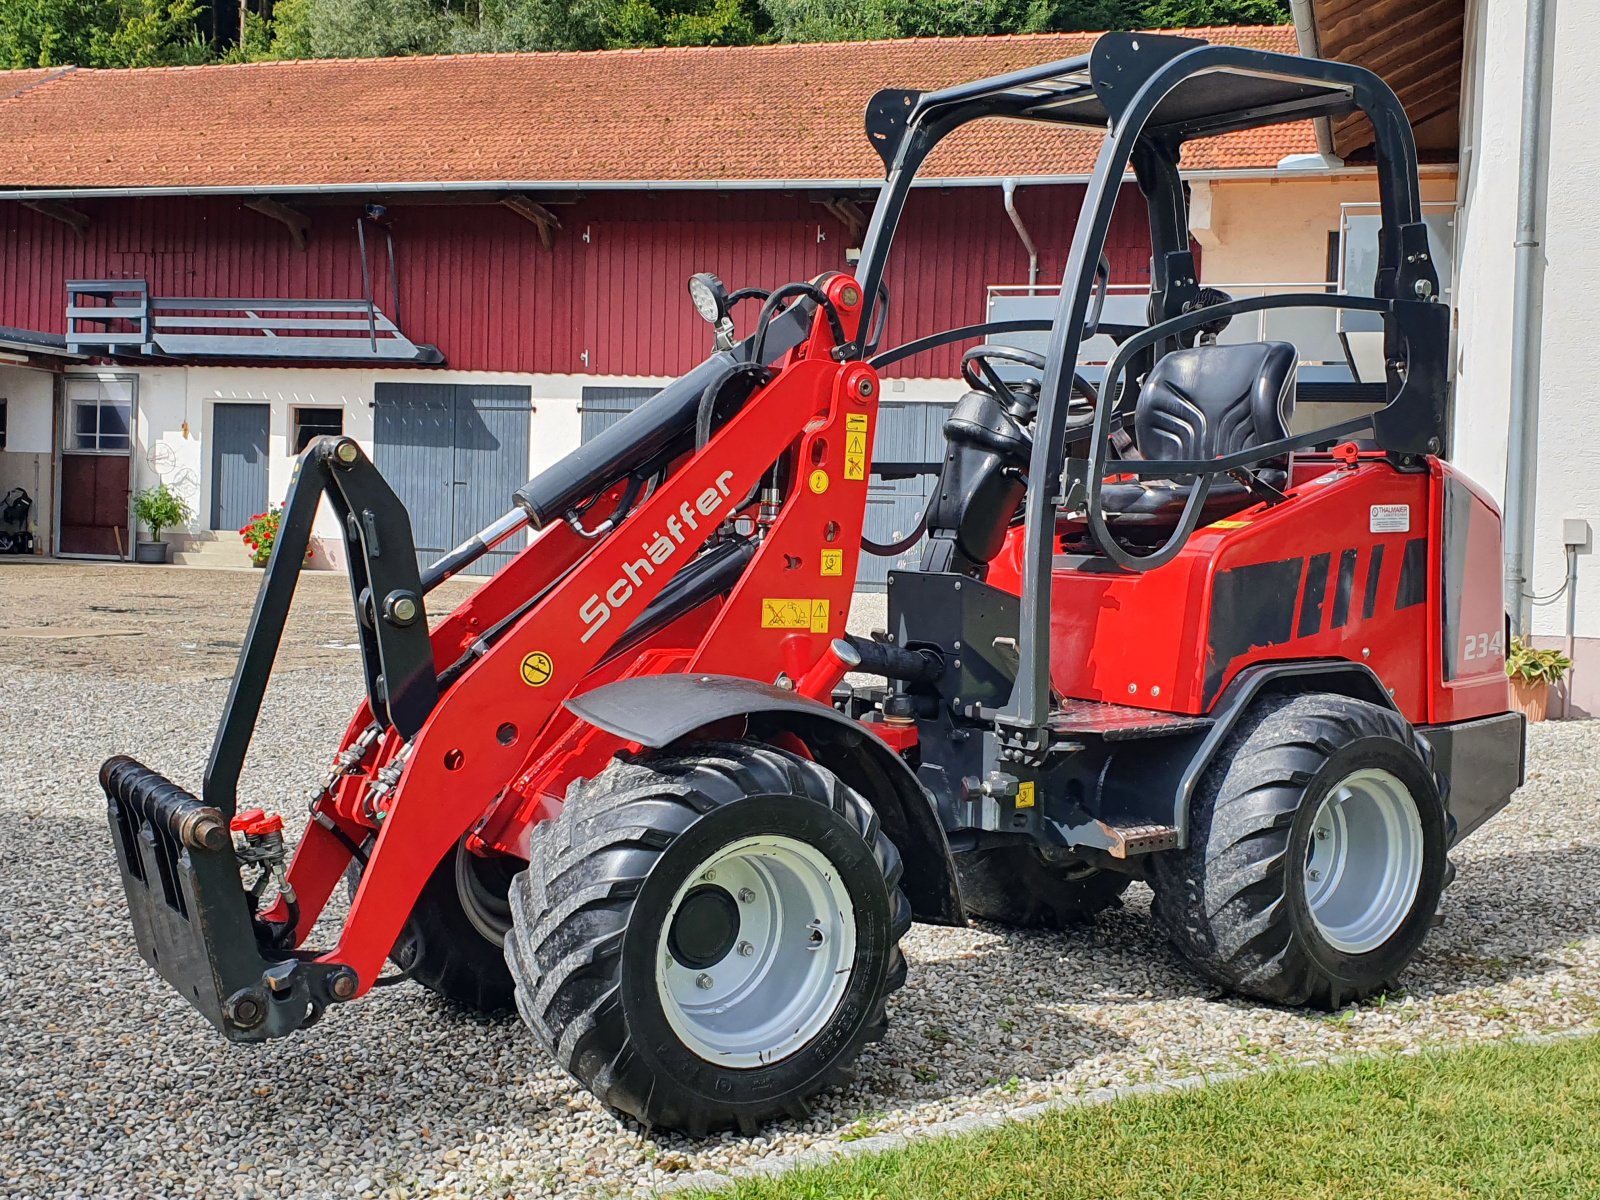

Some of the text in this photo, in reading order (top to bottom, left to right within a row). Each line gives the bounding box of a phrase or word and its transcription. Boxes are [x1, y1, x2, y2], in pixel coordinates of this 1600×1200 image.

[1379, 506, 1408, 514] THALMAIER
[579, 470, 734, 644] Schäffer
[1463, 630, 1503, 660] 234
